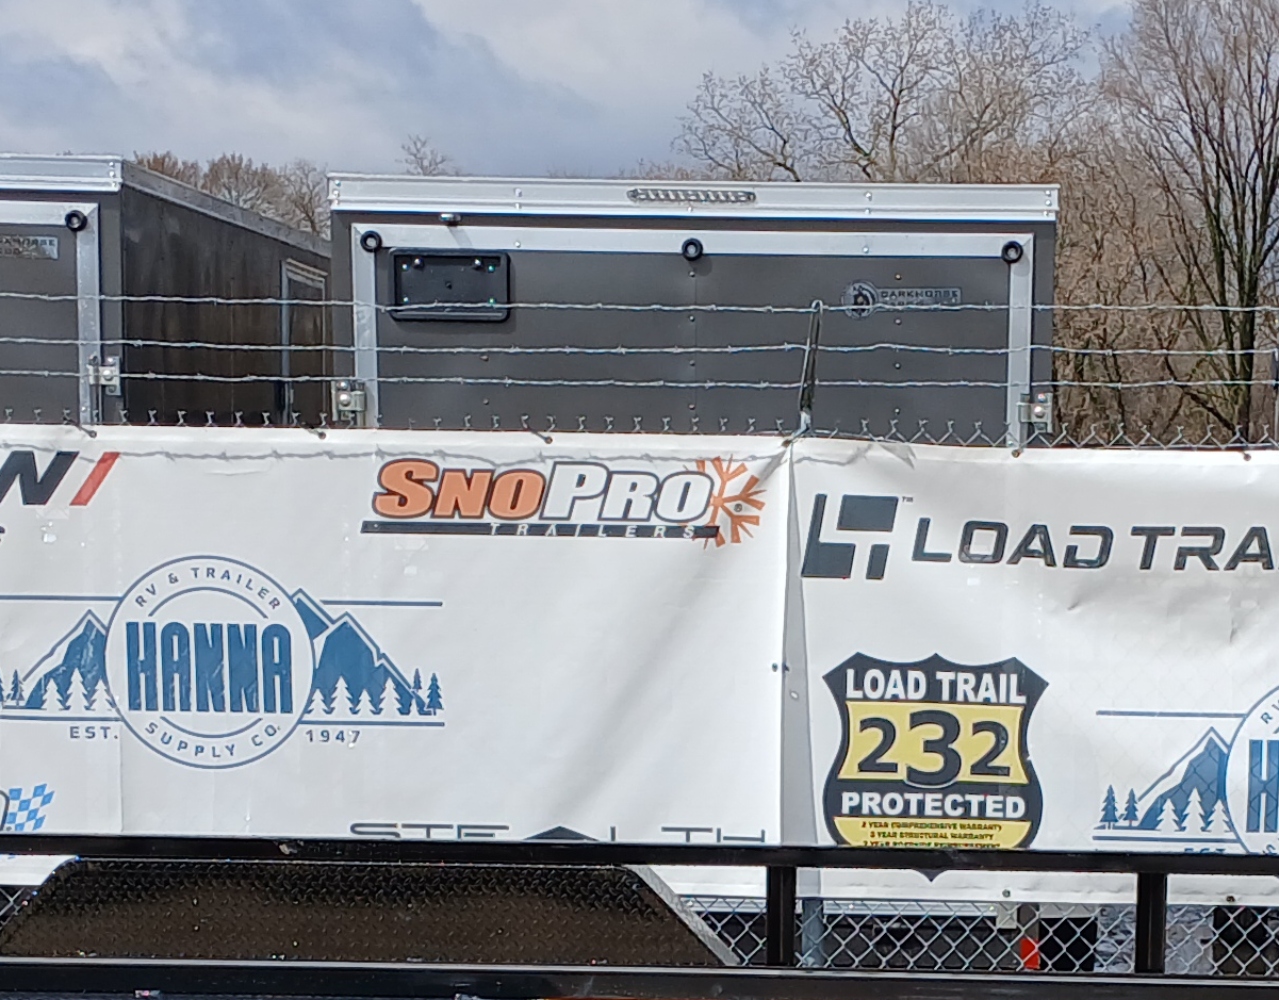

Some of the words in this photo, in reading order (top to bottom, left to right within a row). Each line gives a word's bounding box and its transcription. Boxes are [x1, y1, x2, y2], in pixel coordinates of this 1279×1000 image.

[488, 523, 697, 540] TRAILERS
[911, 516, 1115, 570] LOAD
[134, 583, 158, 608] RV
[167, 572, 180, 584] &
[189, 566, 282, 610] TRAILER
[125, 621, 294, 714] HANNA
[845, 668, 928, 700] LOAD
[935, 671, 1027, 704] TRAIL
[69, 725, 119, 740] EST.
[144, 721, 236, 758] SUPPLY
[250, 723, 282, 748] CO.
[305, 729, 362, 744] 1947
[857, 709, 1012, 785] 232
[840, 791, 1027, 819] PROTECTED
